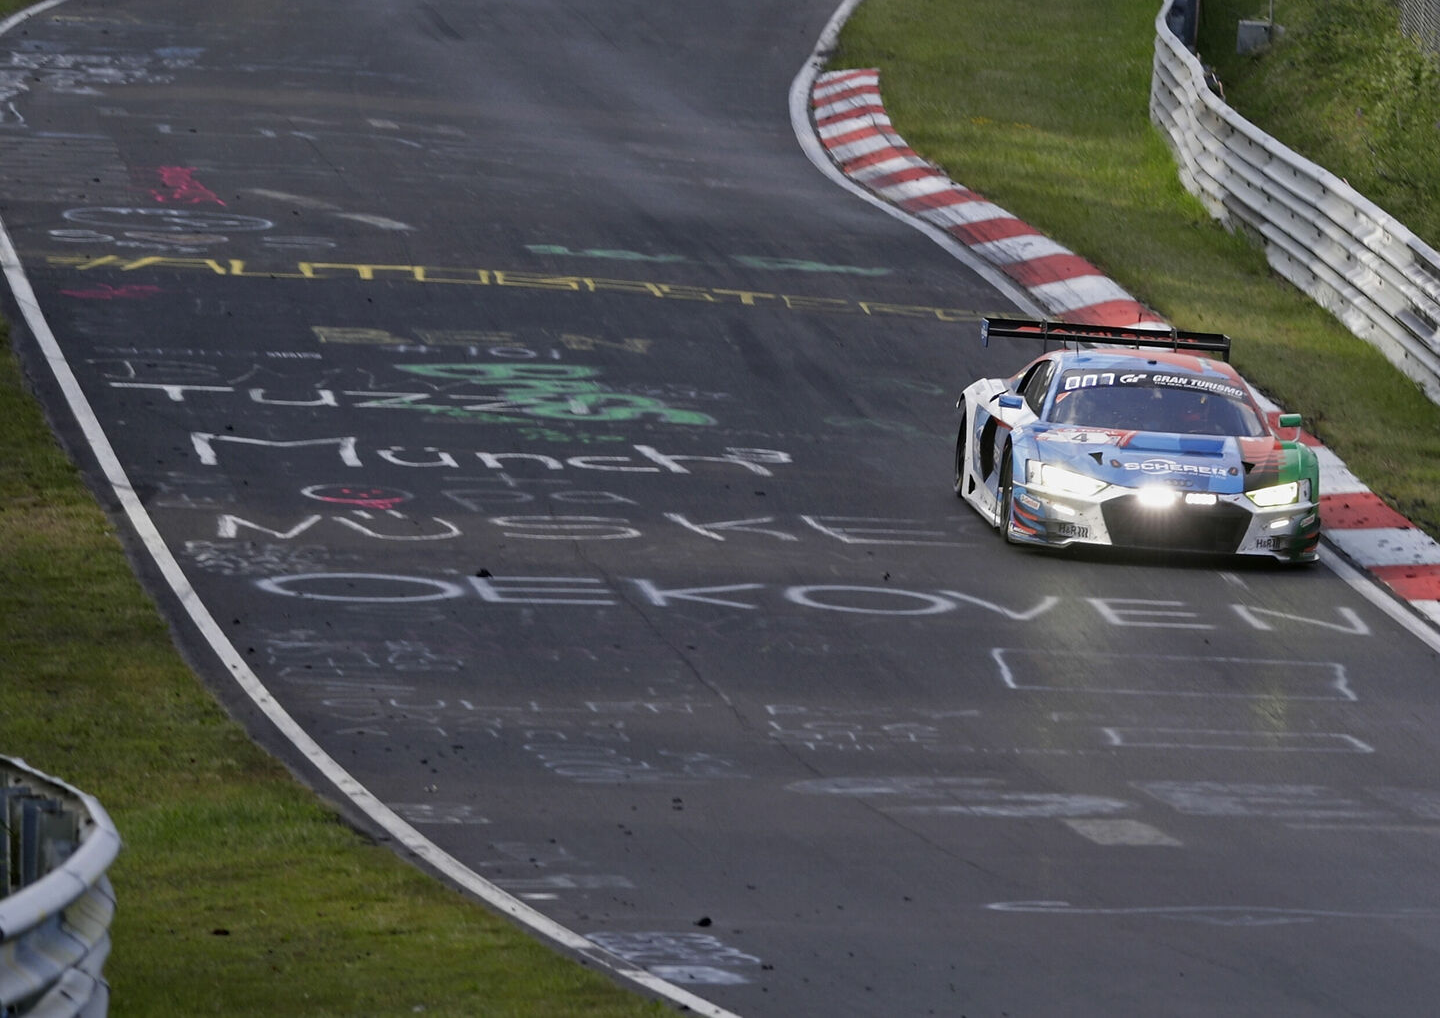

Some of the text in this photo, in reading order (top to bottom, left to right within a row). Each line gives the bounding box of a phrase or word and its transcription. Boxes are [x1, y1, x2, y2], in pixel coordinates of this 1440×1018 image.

[1152, 374, 1188, 385] GRAN
[1189, 378, 1244, 397] TURISMO
[1071, 432, 1088, 443] 4
[1123, 461, 1228, 477] SCHERER
[252, 571, 1372, 637] OEKOVEN
